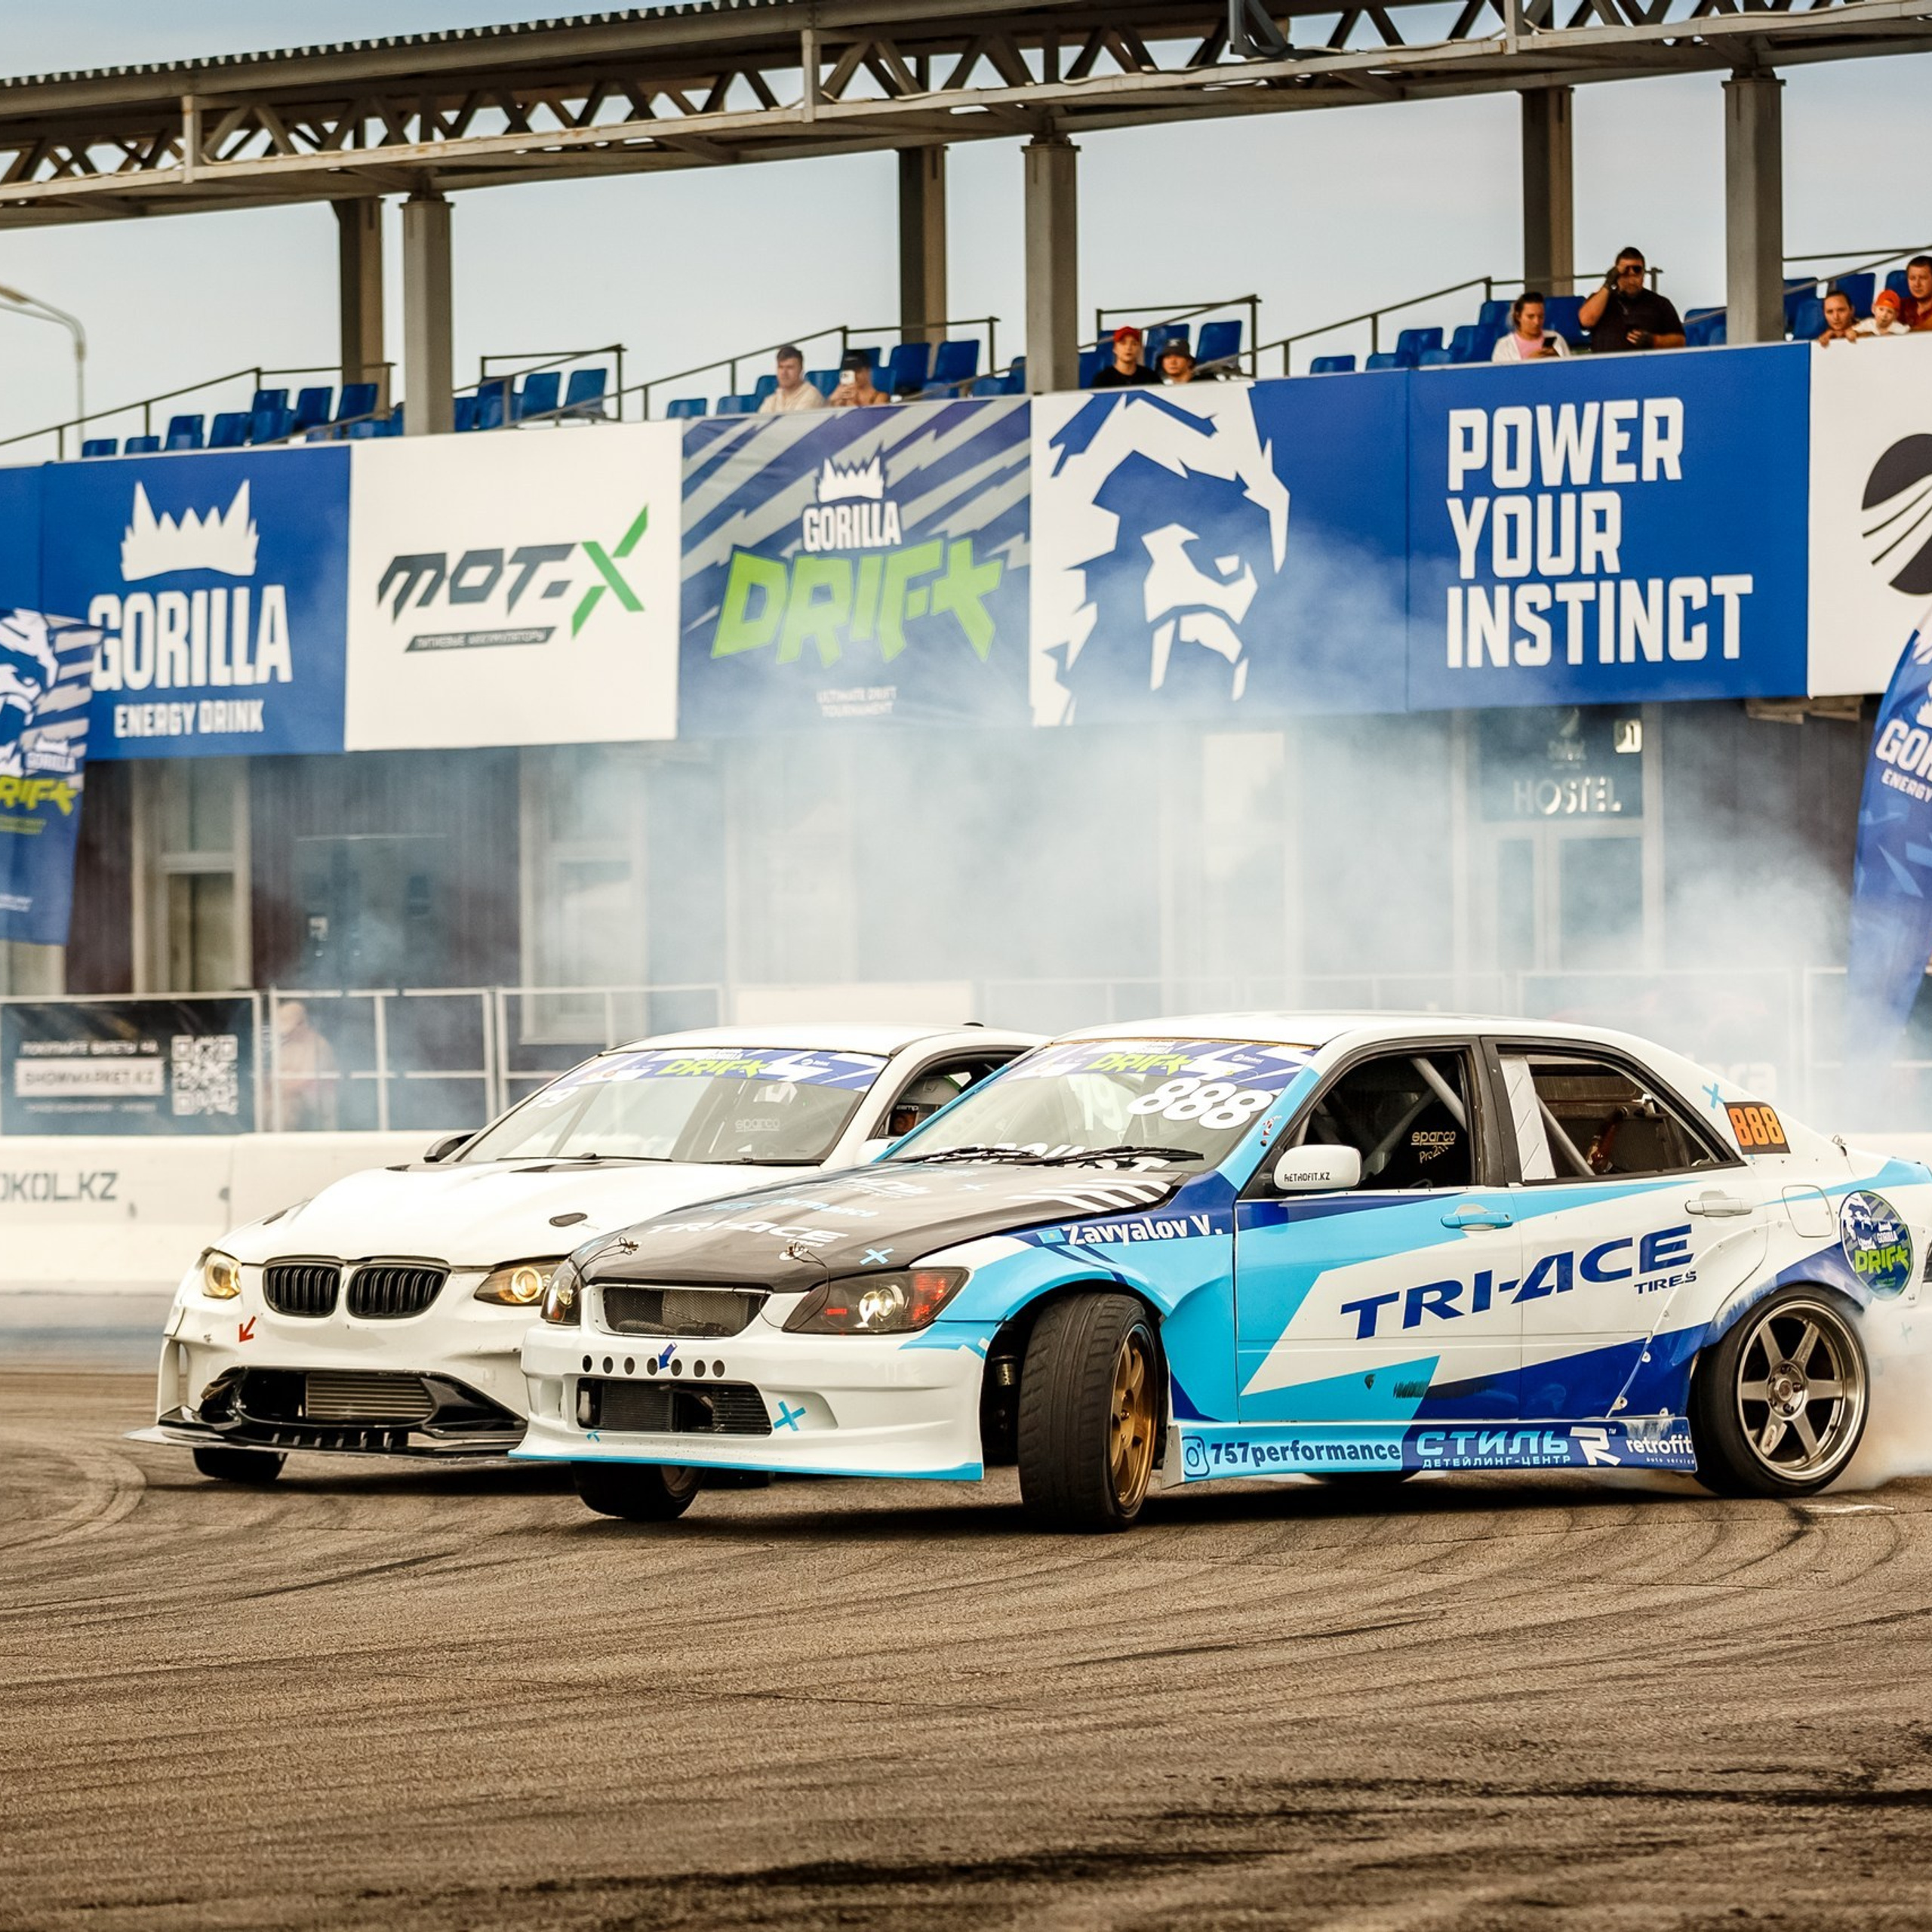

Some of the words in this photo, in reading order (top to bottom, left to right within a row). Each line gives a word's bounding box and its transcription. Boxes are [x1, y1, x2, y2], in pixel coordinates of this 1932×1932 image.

[1448, 397, 1684, 491] POWER
[802, 501, 901, 552] GORILLA
[1446, 490, 1622, 580] YOUR
[88, 584, 293, 691] GORILLA
[1447, 574, 1753, 669] INSTINCT
[114, 702, 196, 737] ENERGY
[198, 699, 264, 734] DRINK
[1513, 775, 1622, 815] HOSTEL
[1127, 1077, 1273, 1129] 888
[735, 1118, 780, 1132] sparco
[1411, 1131, 1456, 1146] sparco
[1728, 1106, 1785, 1146] 888
[1061, 1217, 1186, 1246] Zavyalov
[1190, 1214, 1223, 1235] V.
[1340, 1223, 1695, 1341] TRI-ACE
[1634, 1269, 1697, 1296] TIRES
[1211, 1440, 1401, 1467] 757performance
[1416, 1430, 1568, 1456] СТИЛЬ
[1423, 1454, 1571, 1469] ДЕТЕЙЛИНГ-ЦЕНТР
[1626, 1434, 1694, 1454] retrofit
